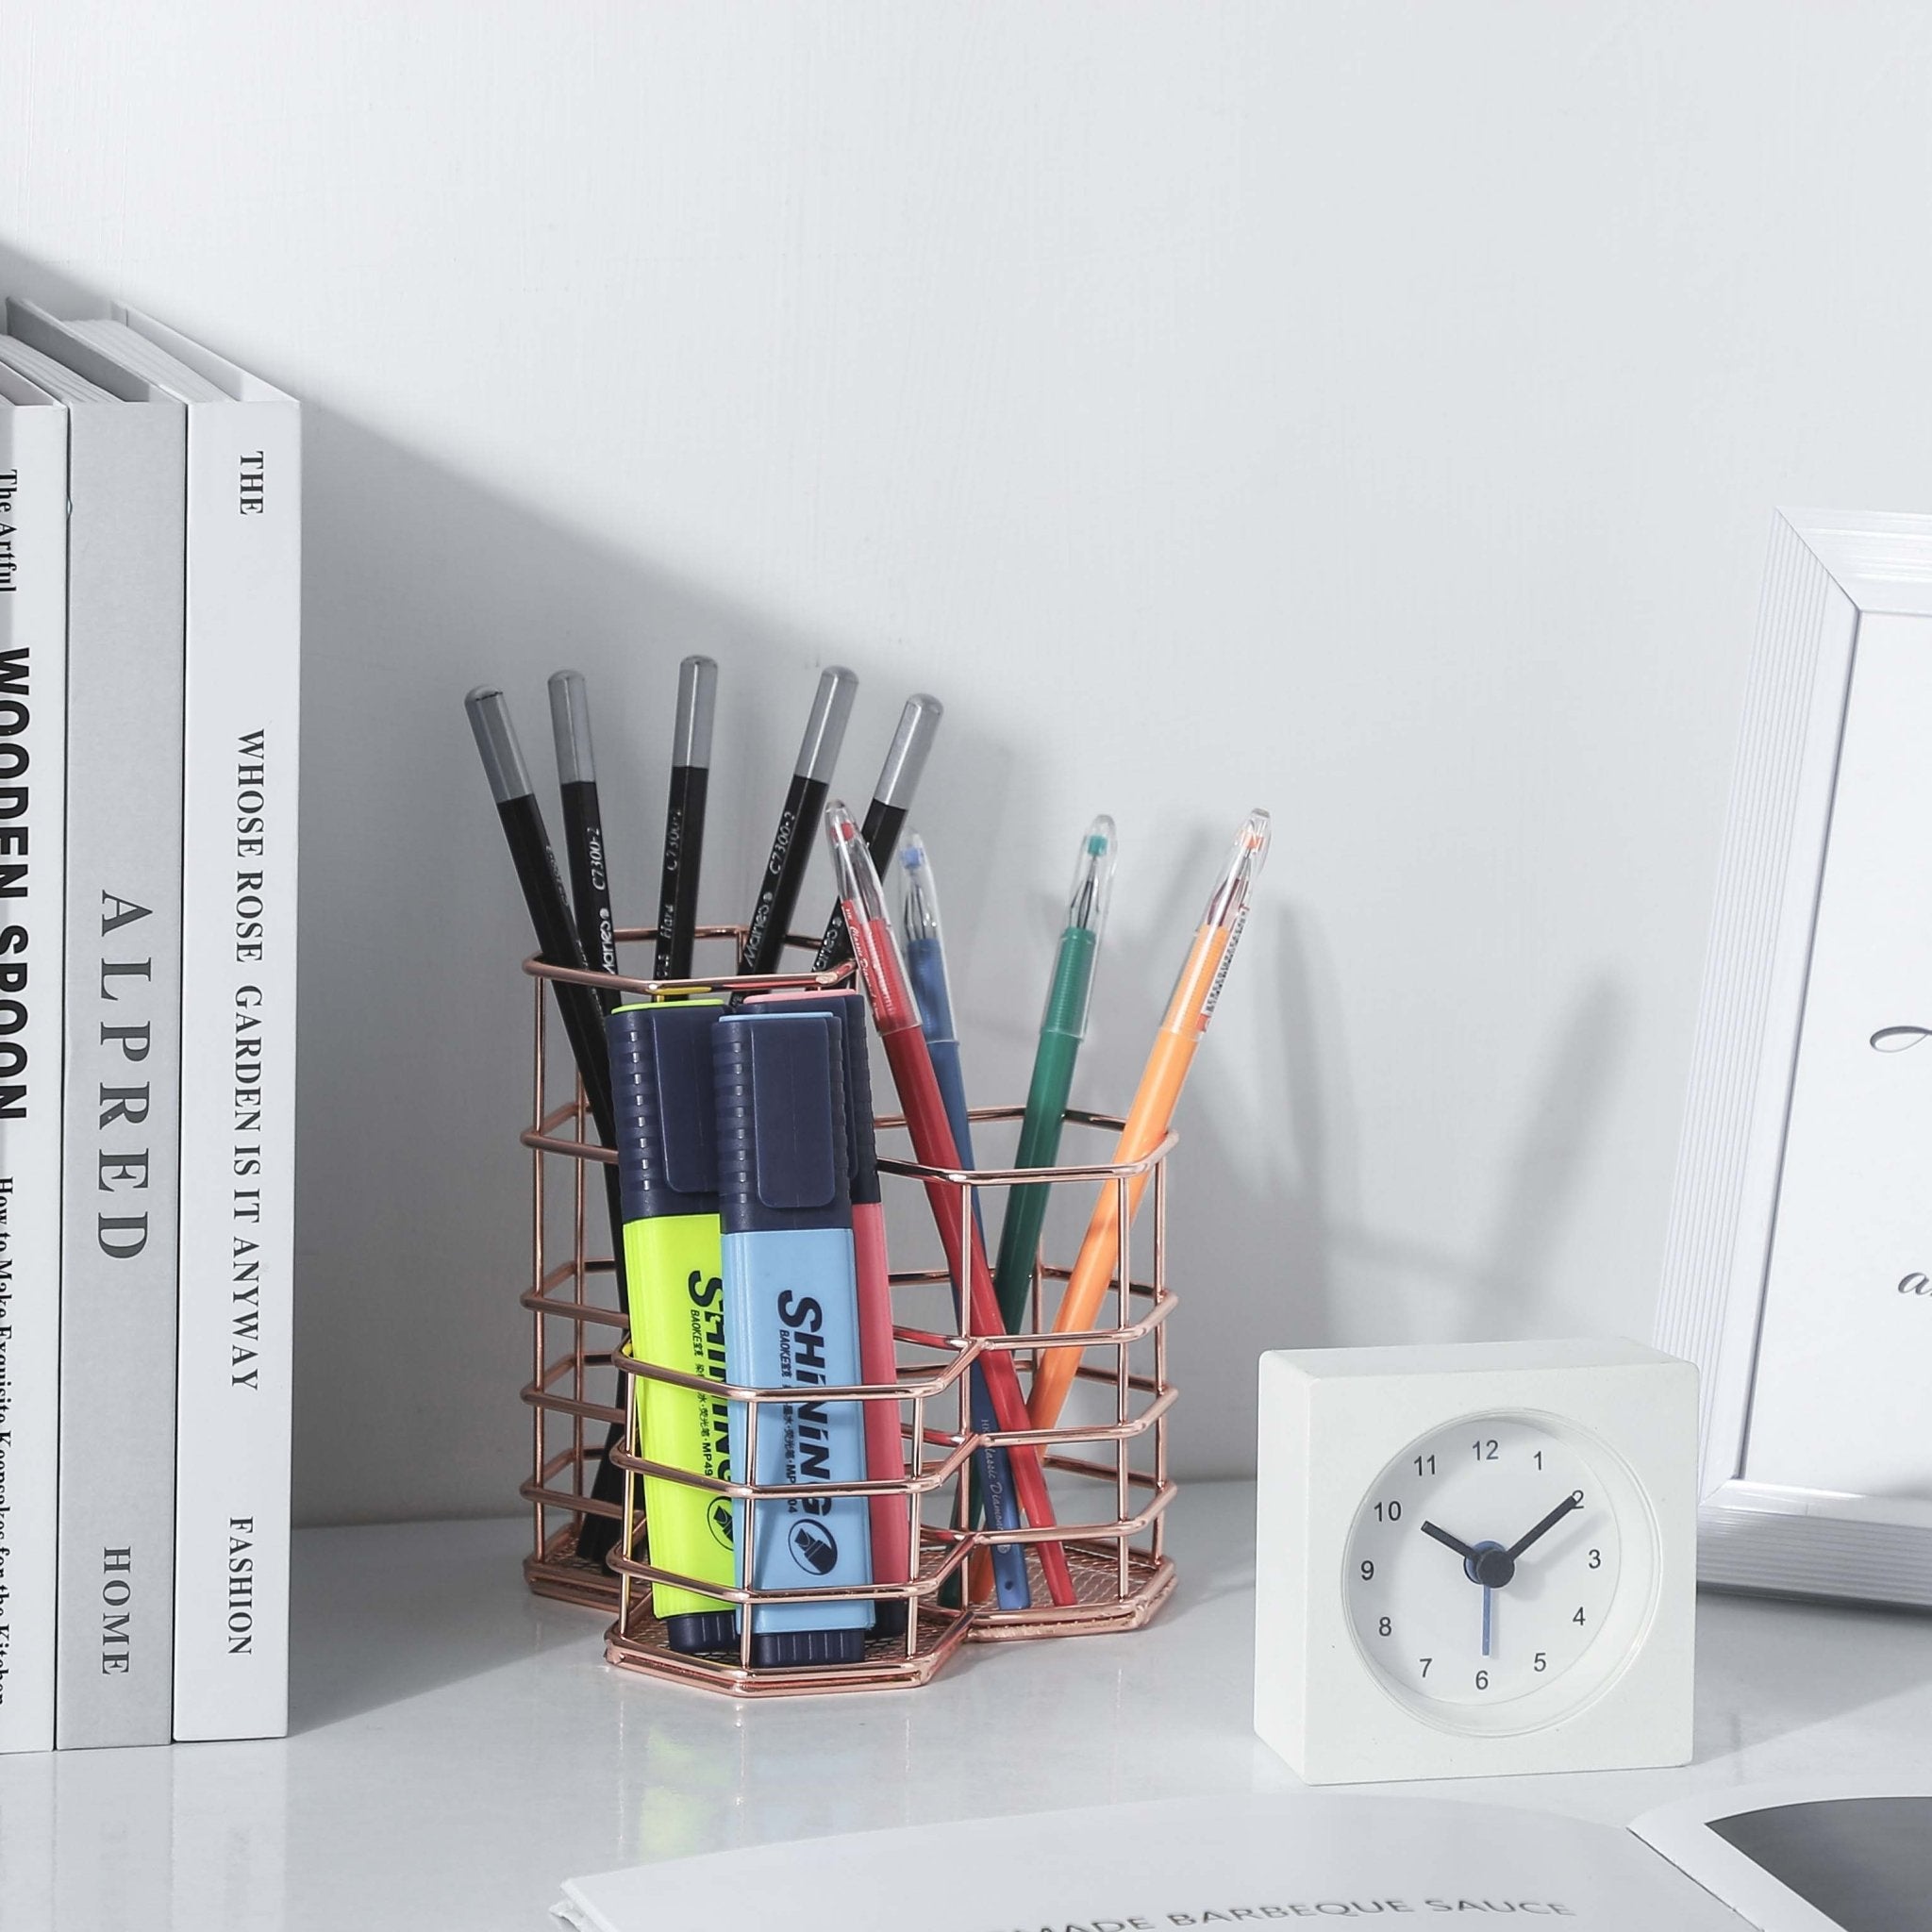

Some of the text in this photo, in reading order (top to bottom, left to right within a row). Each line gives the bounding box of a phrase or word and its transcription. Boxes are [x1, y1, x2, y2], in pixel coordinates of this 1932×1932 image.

[240, 450, 264, 515] THE
[0, 469, 18, 592] The Artful
[770, 811, 795, 874] C7300-2
[586, 826, 607, 891] C7300-2
[0, 647, 30, 1120] WOODEN SPOON
[231, 728, 265, 1391] WHOSE ROSE GARDEN IS IT ANYWAY
[97, 889, 154, 1259] ALPRED
[1472, 1439, 1499, 1461] 12
[1533, 1451, 1542, 1471] 1
[984, 1449, 996, 1479] lassic
[1413, 1454, 1436, 1477] 11
[1374, 1500, 1402, 1523] 10
[1360, 1559, 1374, 1582] 9
[1588, 1549, 1601, 1570] 3
[227, 1516, 254, 1655] FASHION
[102, 1546, 131, 1675] HOME
[1572, 1607, 1586, 1626] 4
[1378, 1616, 1392, 1637] 8
[1419, 1657, 1433, 1678] 7
[1534, 1652, 1546, 1673] 5
[1475, 1670, 1489, 1690] 6
[1166, 1899, 1415, 1926] BARBEQUE
[1424, 1899, 1576, 1917] SAUCE
